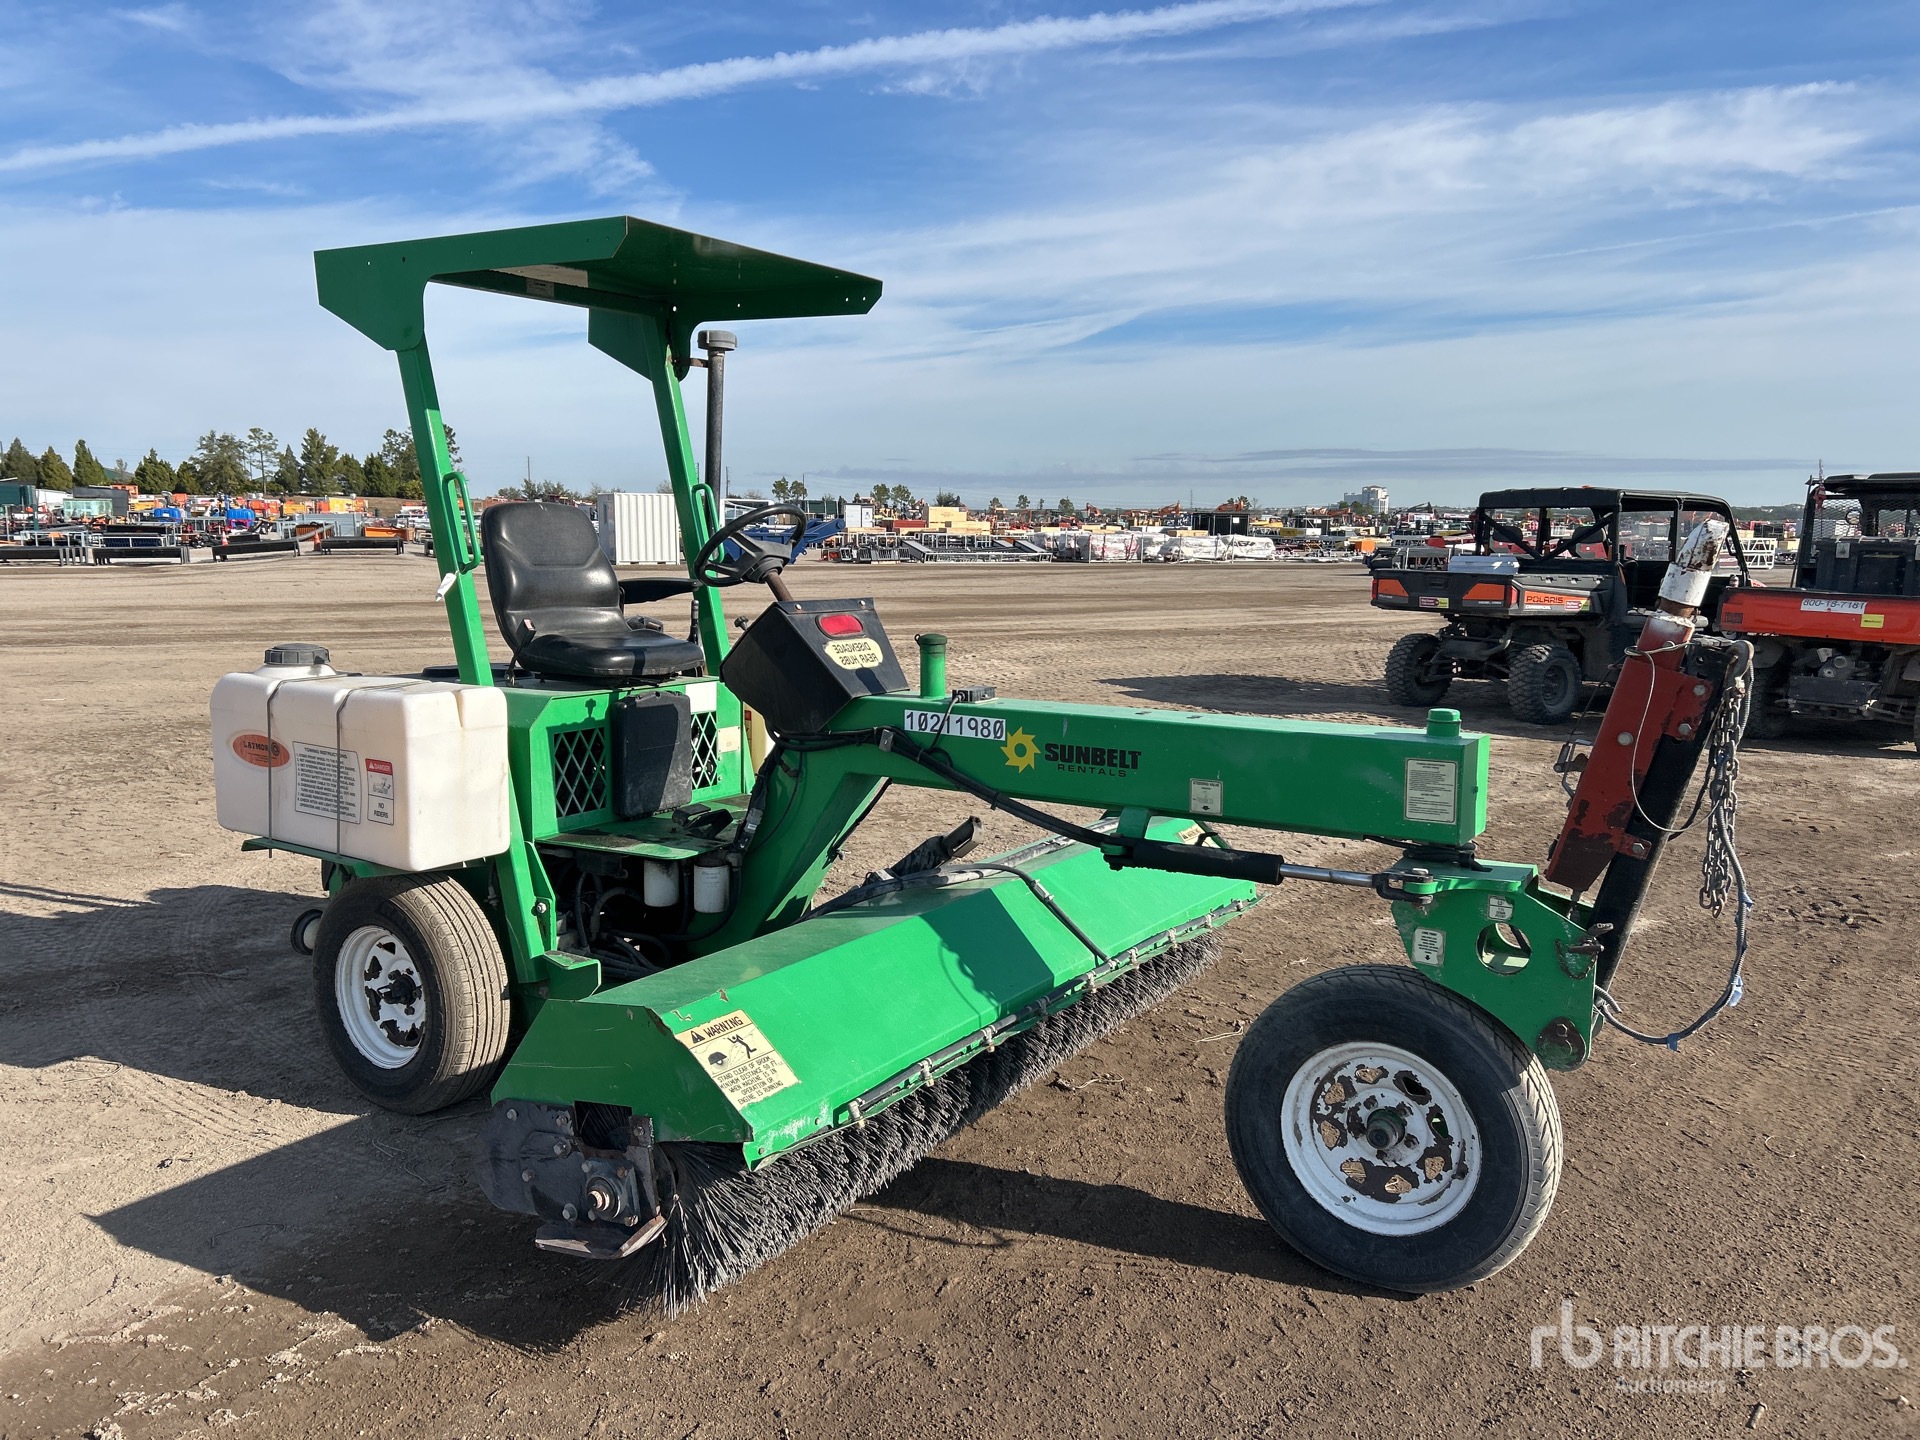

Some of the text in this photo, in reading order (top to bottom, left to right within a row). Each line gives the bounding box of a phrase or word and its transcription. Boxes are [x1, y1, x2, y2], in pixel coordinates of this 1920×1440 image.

[1526, 595, 1564, 604] POLARIS
[906, 711, 1004, 740] 10211980
[320, 750, 347, 759] INSTRUCTONS
[1044, 743, 1142, 769] SUNBELT
[373, 763, 390, 771] DANGER
[1057, 763, 1127, 777] RENTALS
[373, 810, 388, 818] RIDERS
[703, 1016, 744, 1038] WARNING
[718, 1072, 733, 1082] STAND
[733, 1065, 748, 1076] CLEAR
[720, 1077, 740, 1089] MINIMUM
[740, 1067, 763, 1081] DISTANCE
[729, 1084, 742, 1093] WHEN
[742, 1075, 762, 1087] MACHINE
[738, 1093, 756, 1105] ENGINE
[763, 1080, 783, 1092] RUNNING
[741, 1080, 767, 1096] OPERATION
